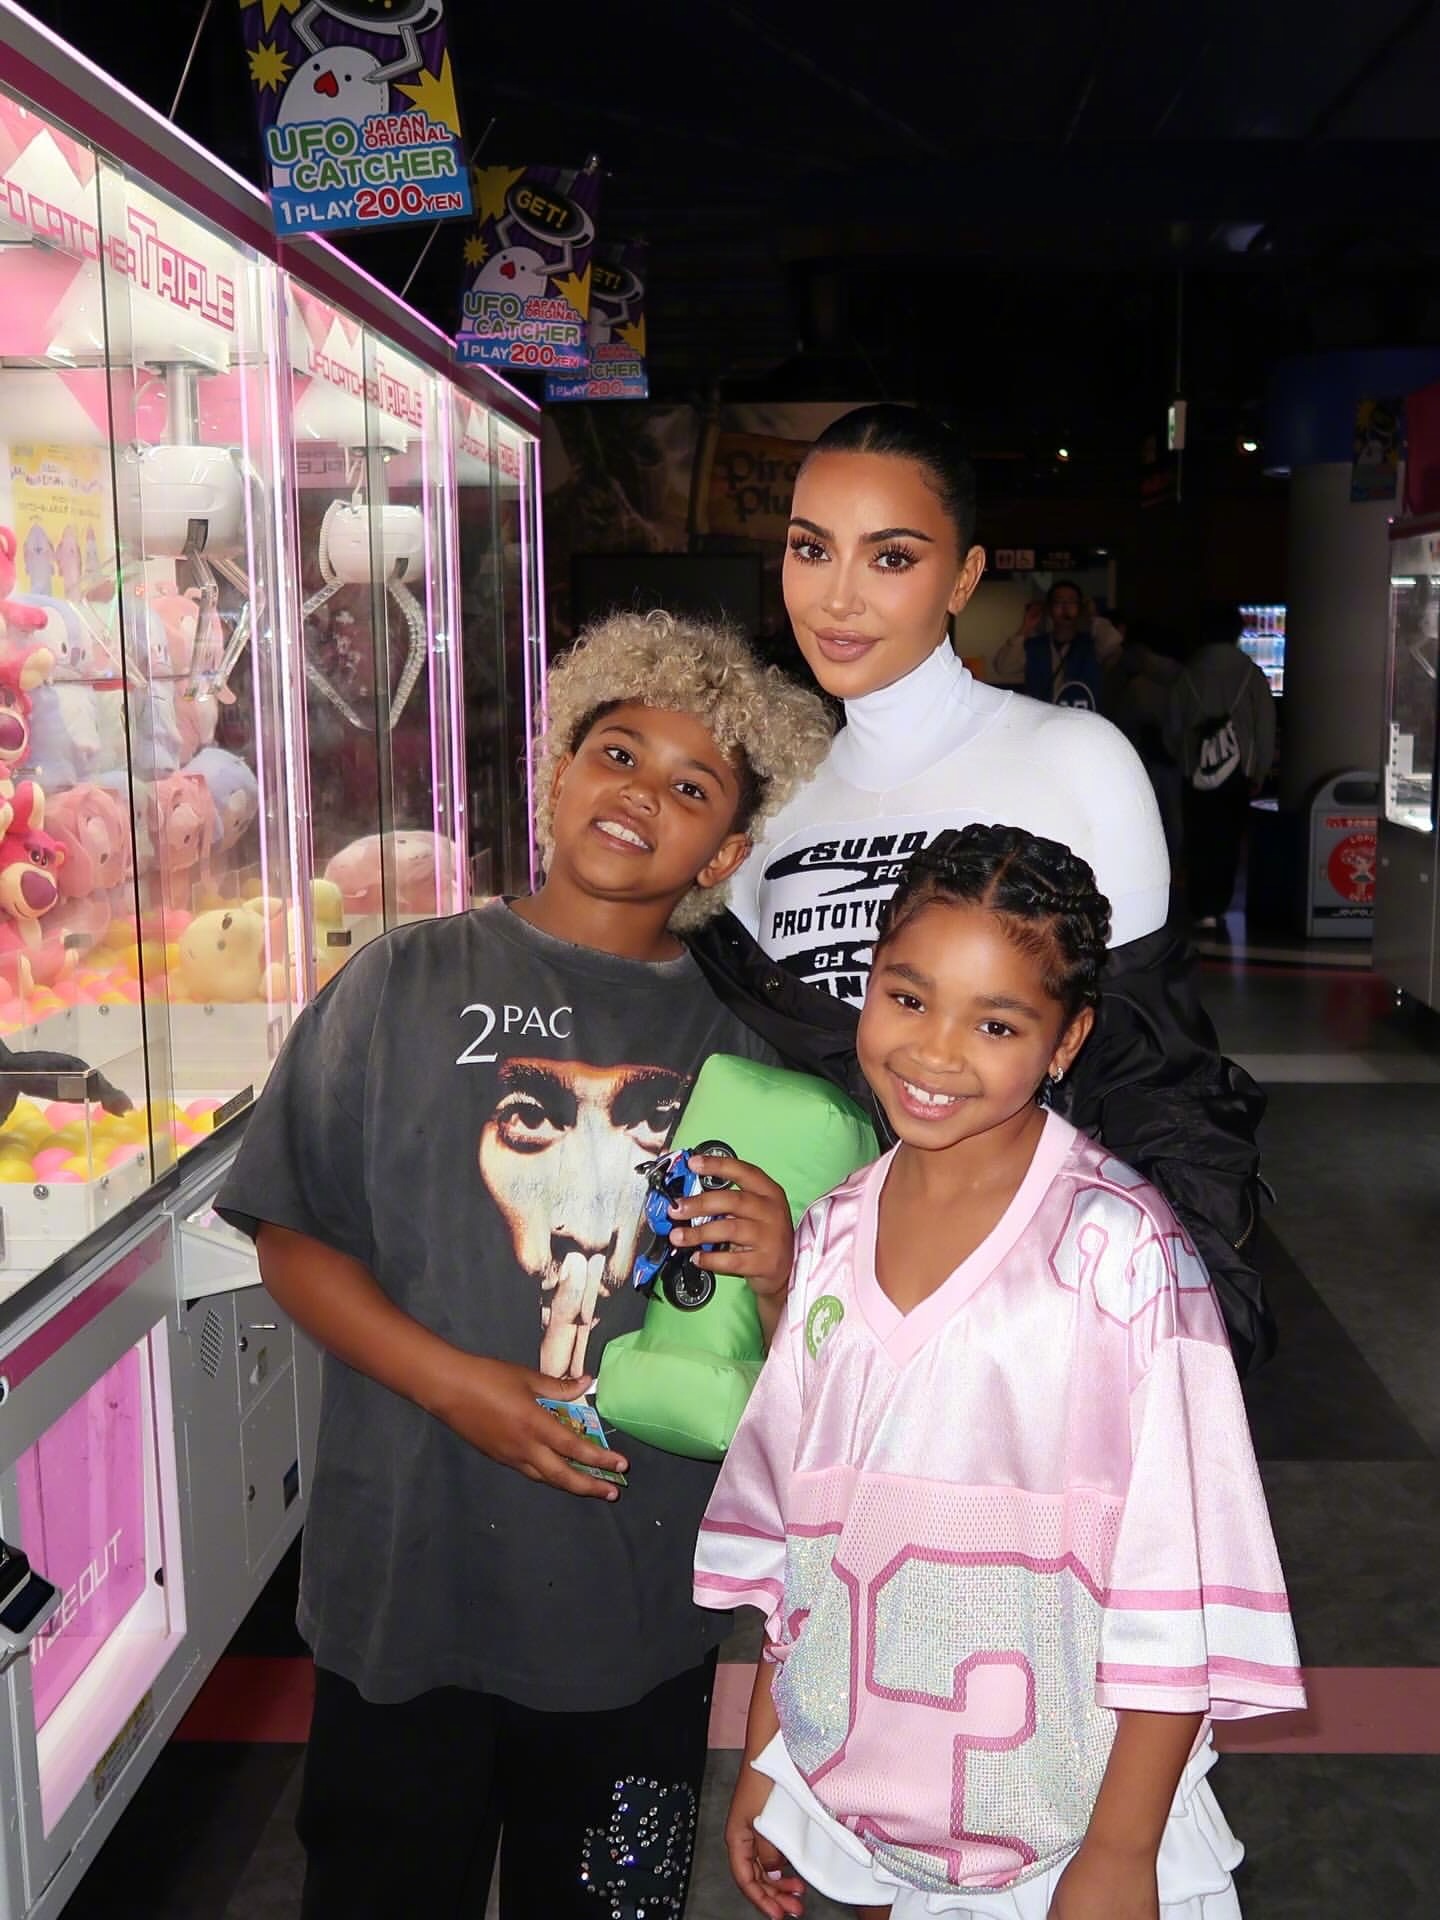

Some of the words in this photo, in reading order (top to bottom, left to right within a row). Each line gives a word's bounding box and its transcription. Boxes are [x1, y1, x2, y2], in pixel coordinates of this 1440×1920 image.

[365, 116, 425, 134] JAPAN
[268, 123, 355, 162] UFO
[365, 128, 451, 149] ORIGINAL
[295, 149, 456, 190] CATCHER
[516, 189, 569, 229] GET!
[127, 206, 234, 331] TRIPLE
[592, 267, 622, 290] ET!
[464, 293, 520, 319] UFO
[526, 299, 566, 313] JAPAN
[475, 318, 580, 343] CATCHER
[873, 864, 903, 880] FC
